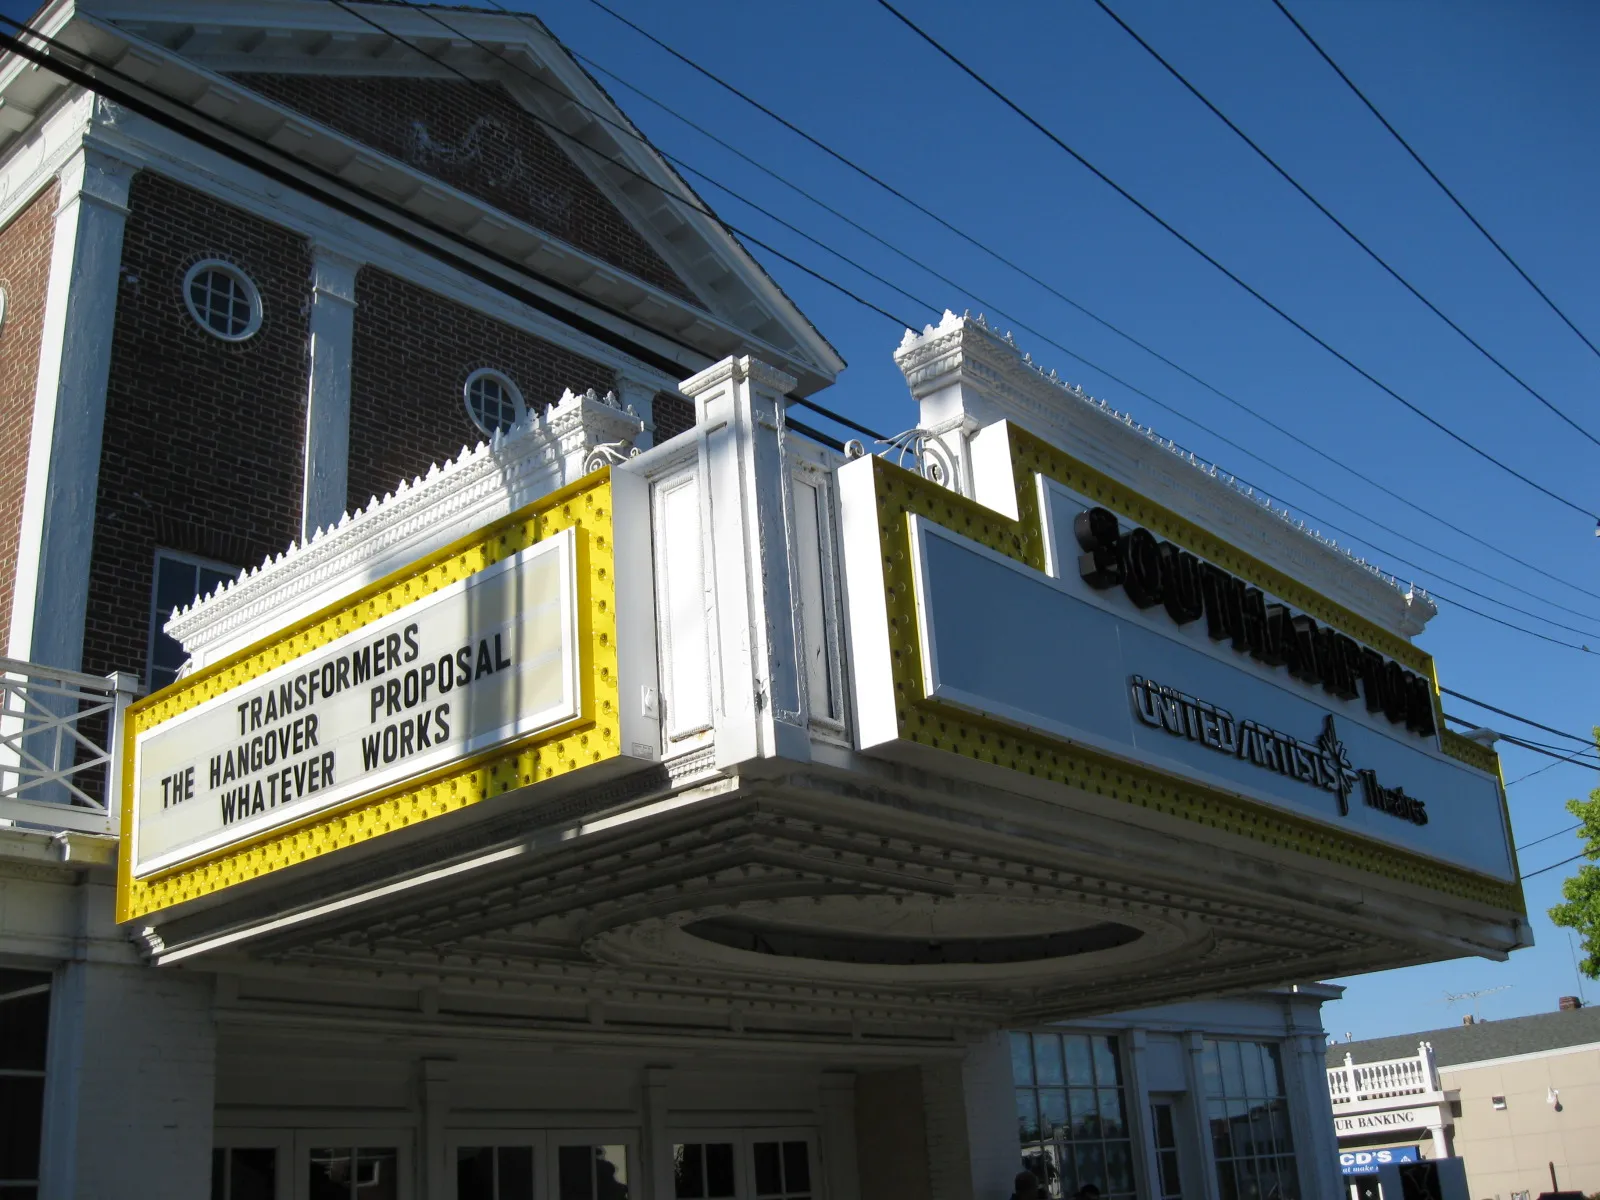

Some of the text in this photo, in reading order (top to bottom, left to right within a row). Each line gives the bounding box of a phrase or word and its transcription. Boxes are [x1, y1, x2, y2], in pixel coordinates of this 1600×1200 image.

[238, 623, 420, 735] TRANSFORMERS
[1074, 507, 1435, 736] SOUTHAMPTON
[161, 633, 511, 809] THE HANGOVER PROPOSAL
[220, 703, 450, 825] WHATEVER WORKS
[1131, 674, 1238, 754] UNITED
[1238, 719, 1340, 793] ARTISTS
[1336, 1111, 1414, 1131] UR BANKING
[1339, 1150, 1392, 1166] CD'S
